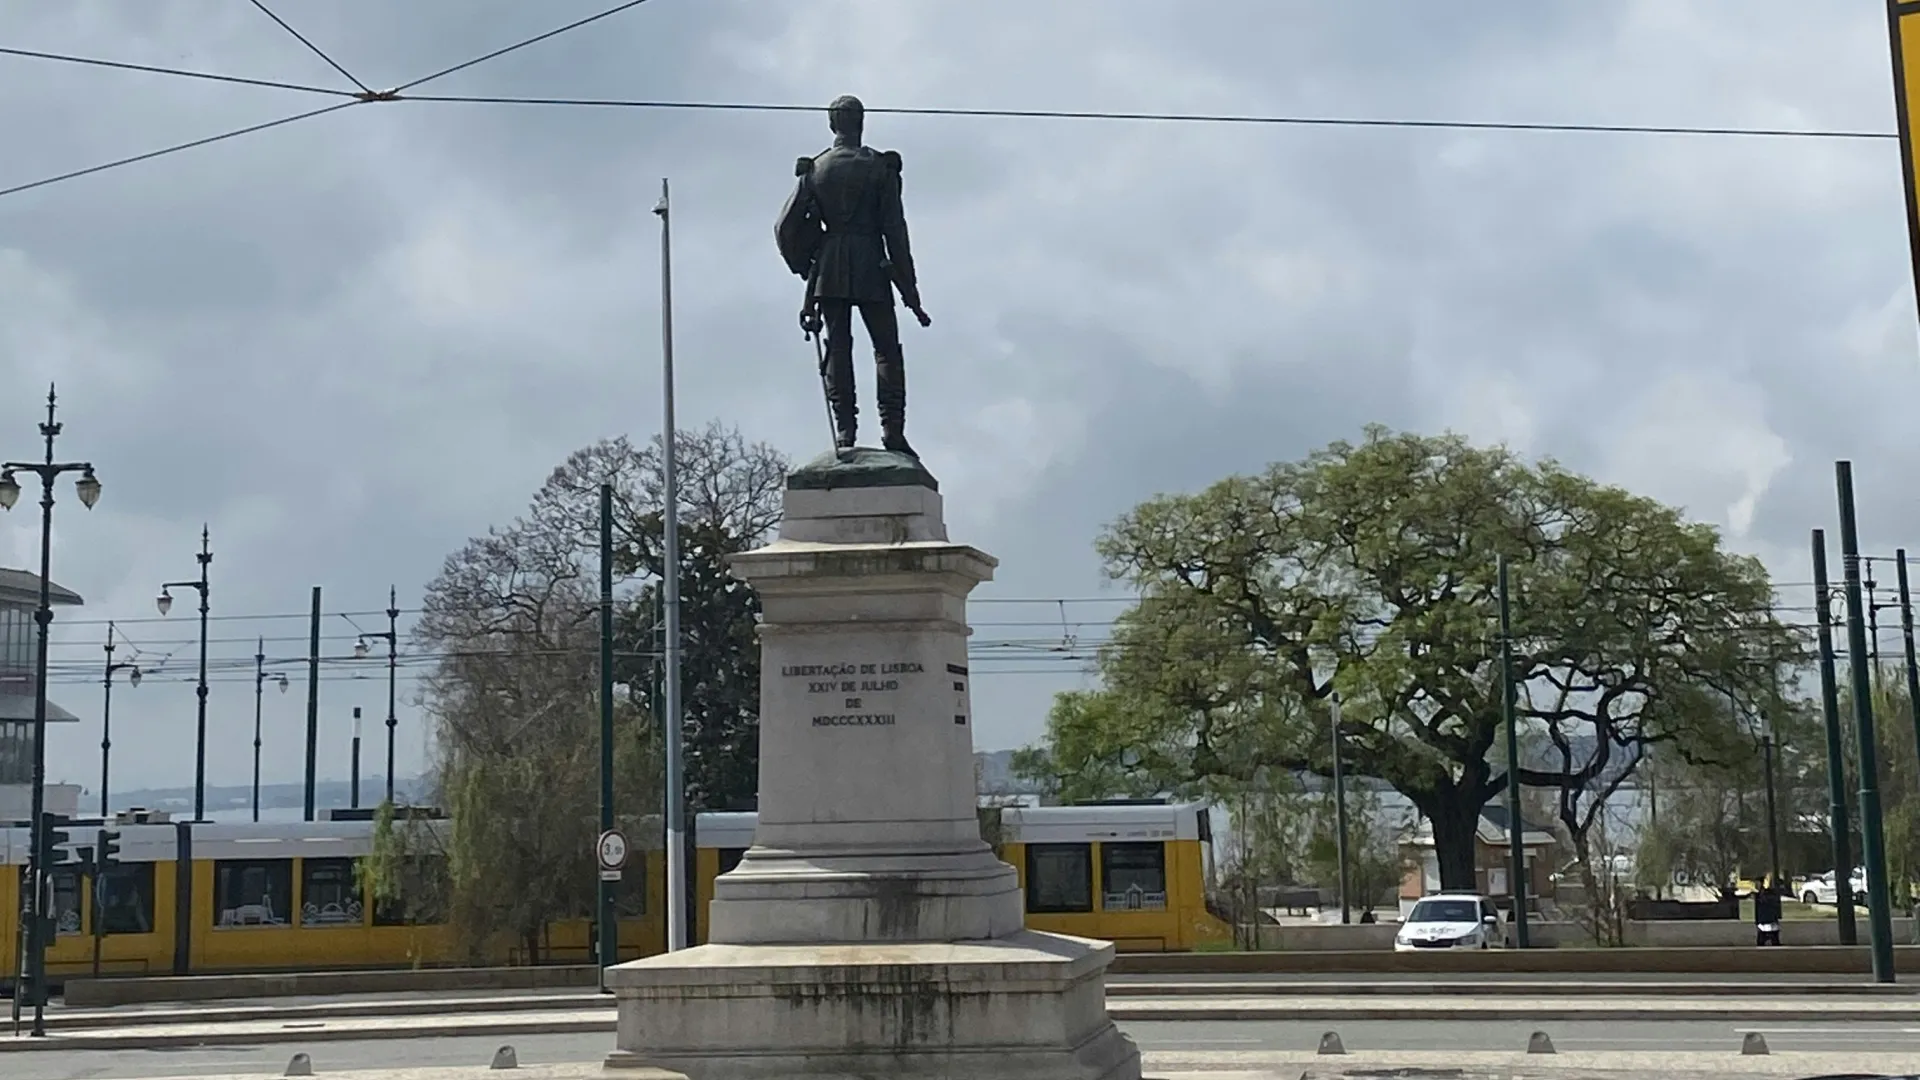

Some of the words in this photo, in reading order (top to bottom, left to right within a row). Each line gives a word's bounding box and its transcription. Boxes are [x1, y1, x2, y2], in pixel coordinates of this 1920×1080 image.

[782, 661, 856, 678] LIBERTAÇÃO
[860, 664, 877, 675] DE
[881, 662, 924, 674] LISBOA
[808, 682, 837, 693] XXIV
[841, 681, 857, 692] DE
[861, 680, 899, 691] JULHO
[845, 698, 862, 708] DE
[812, 715, 896, 727] MDCCCXXXIII
